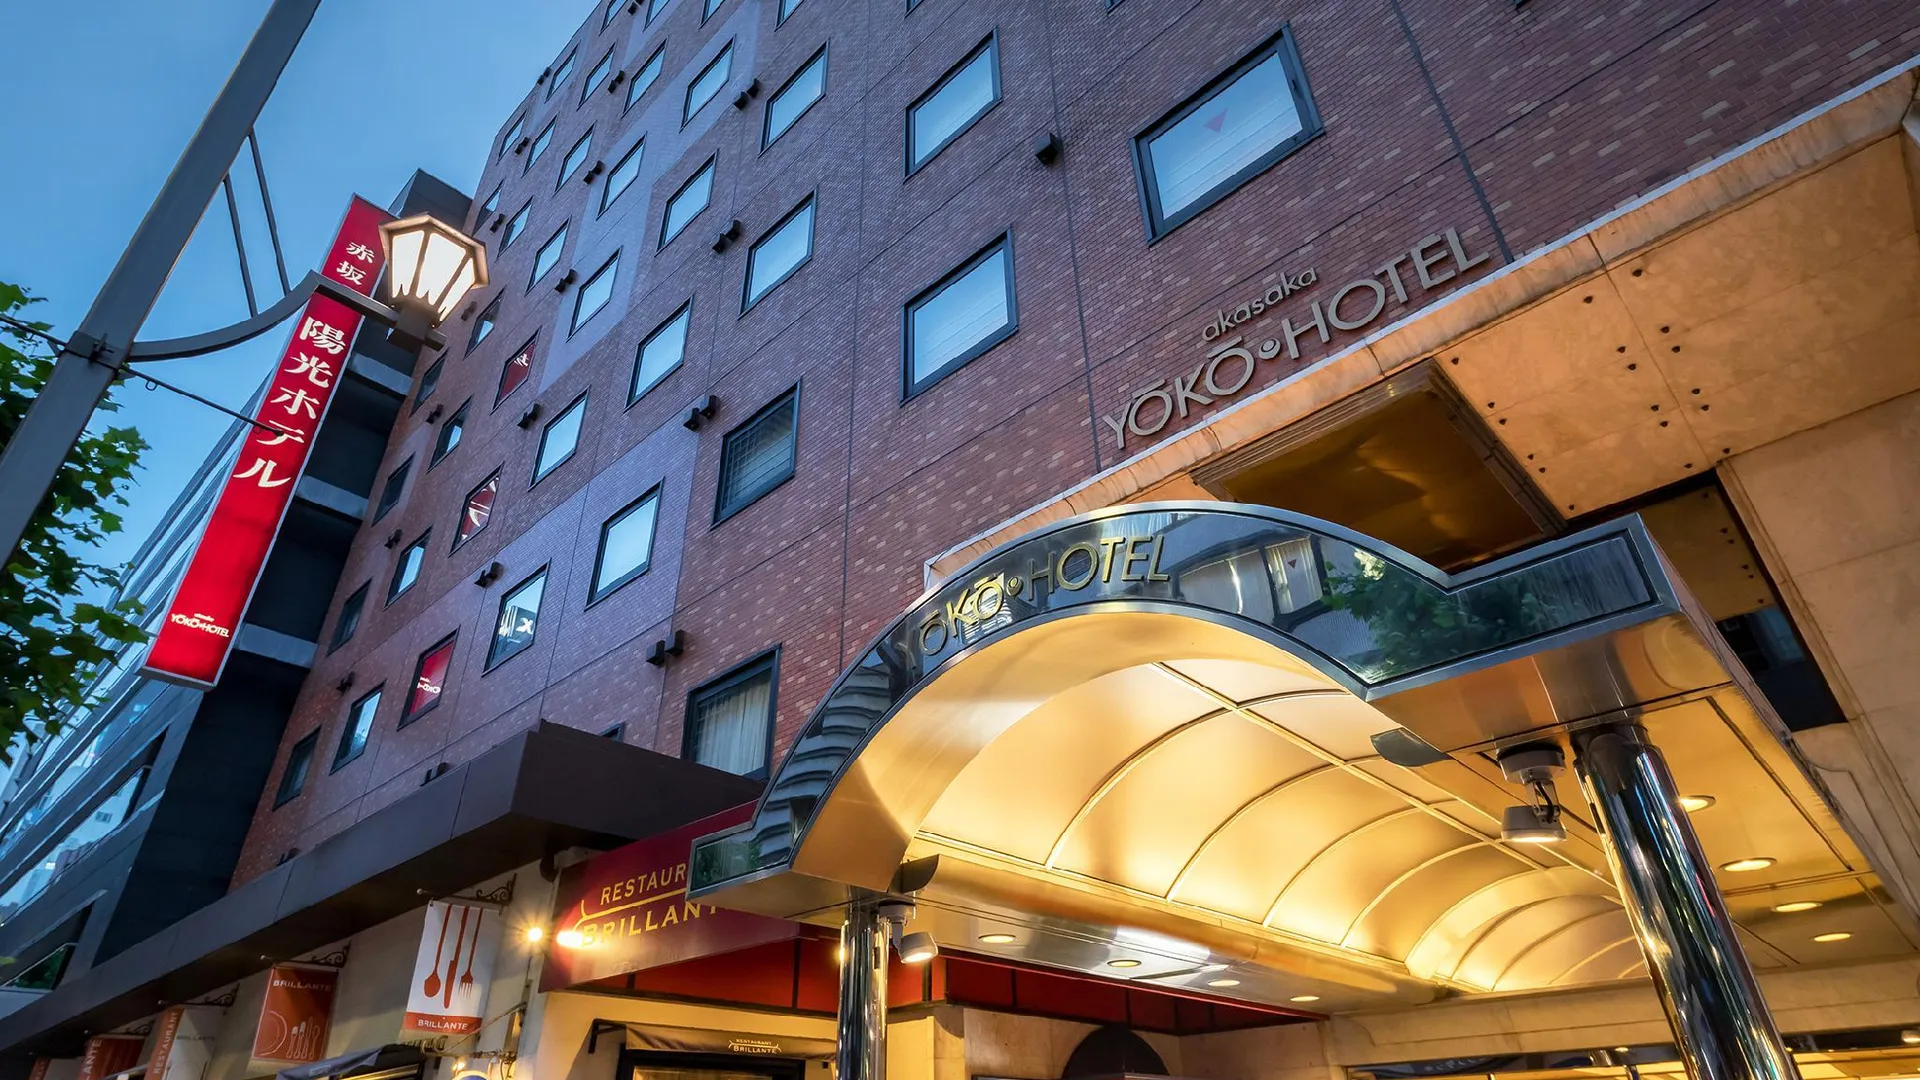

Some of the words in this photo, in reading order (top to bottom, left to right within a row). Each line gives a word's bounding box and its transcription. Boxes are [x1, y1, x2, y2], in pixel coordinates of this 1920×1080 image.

[336, 241, 375, 285] 赤坂
[1202, 267, 1318, 342] akasaka
[1281, 227, 1490, 360] HOTEL
[233, 316, 346, 488] 陽光ホテル
[1028, 534, 1171, 602] HOTEL
[202, 622, 230, 638] HOTEL
[600, 862, 687, 906] RESTAUR
[582, 900, 717, 946] BRILLAN
[273, 979, 332, 992] BRILLANTE
[152, 1011, 180, 1076] RESTAURANT
[418, 1019, 468, 1031] BRILLANTE
[733, 1045, 777, 1053] BRILLANTE
